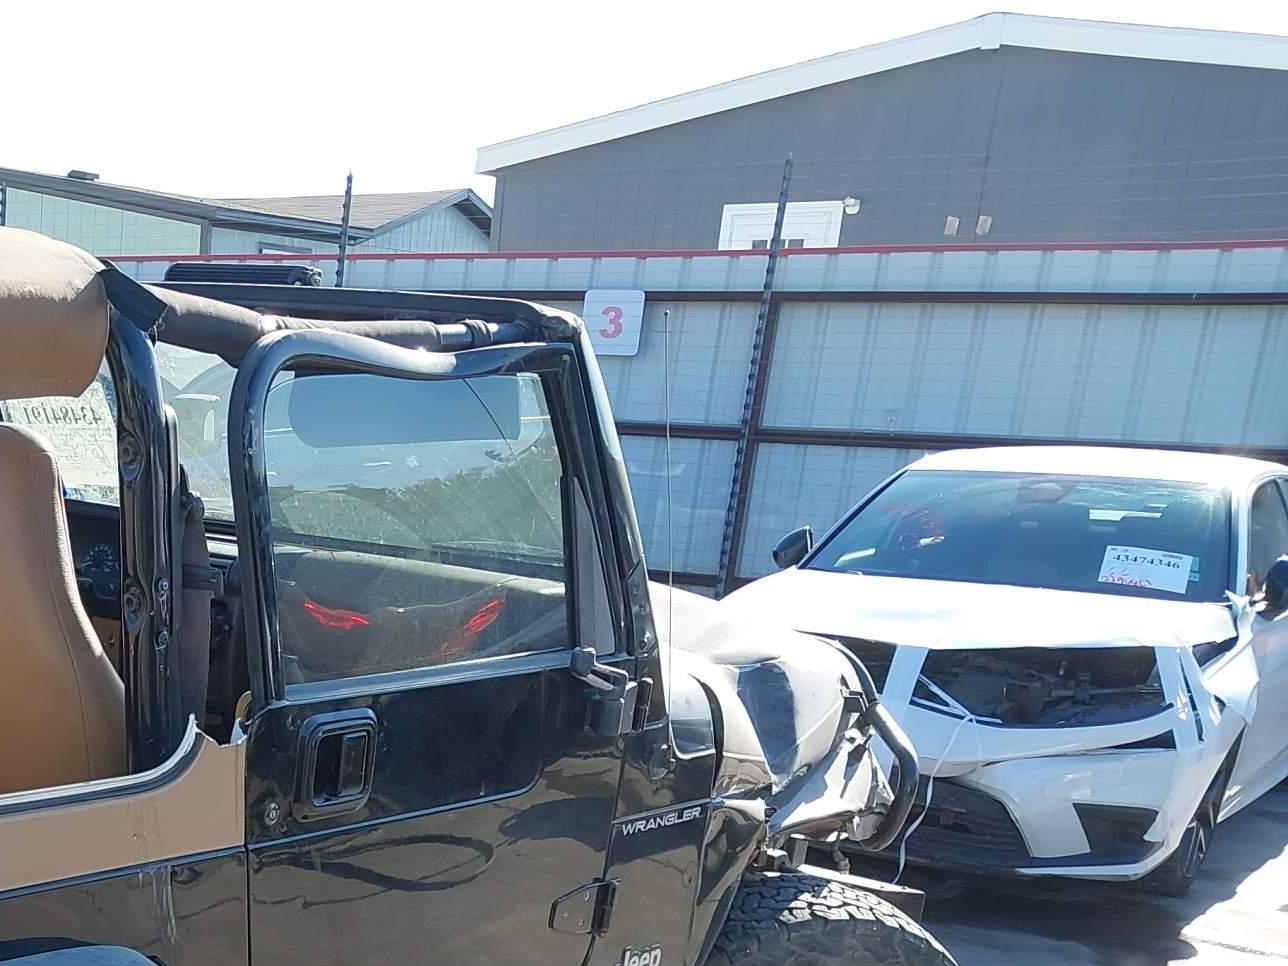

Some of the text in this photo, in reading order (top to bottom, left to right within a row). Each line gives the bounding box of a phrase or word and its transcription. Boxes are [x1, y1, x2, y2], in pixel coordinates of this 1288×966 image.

[598, 305, 623, 339] 3
[1112, 554, 1181, 570] 43474346
[621, 806, 702, 837] WRANGLER
